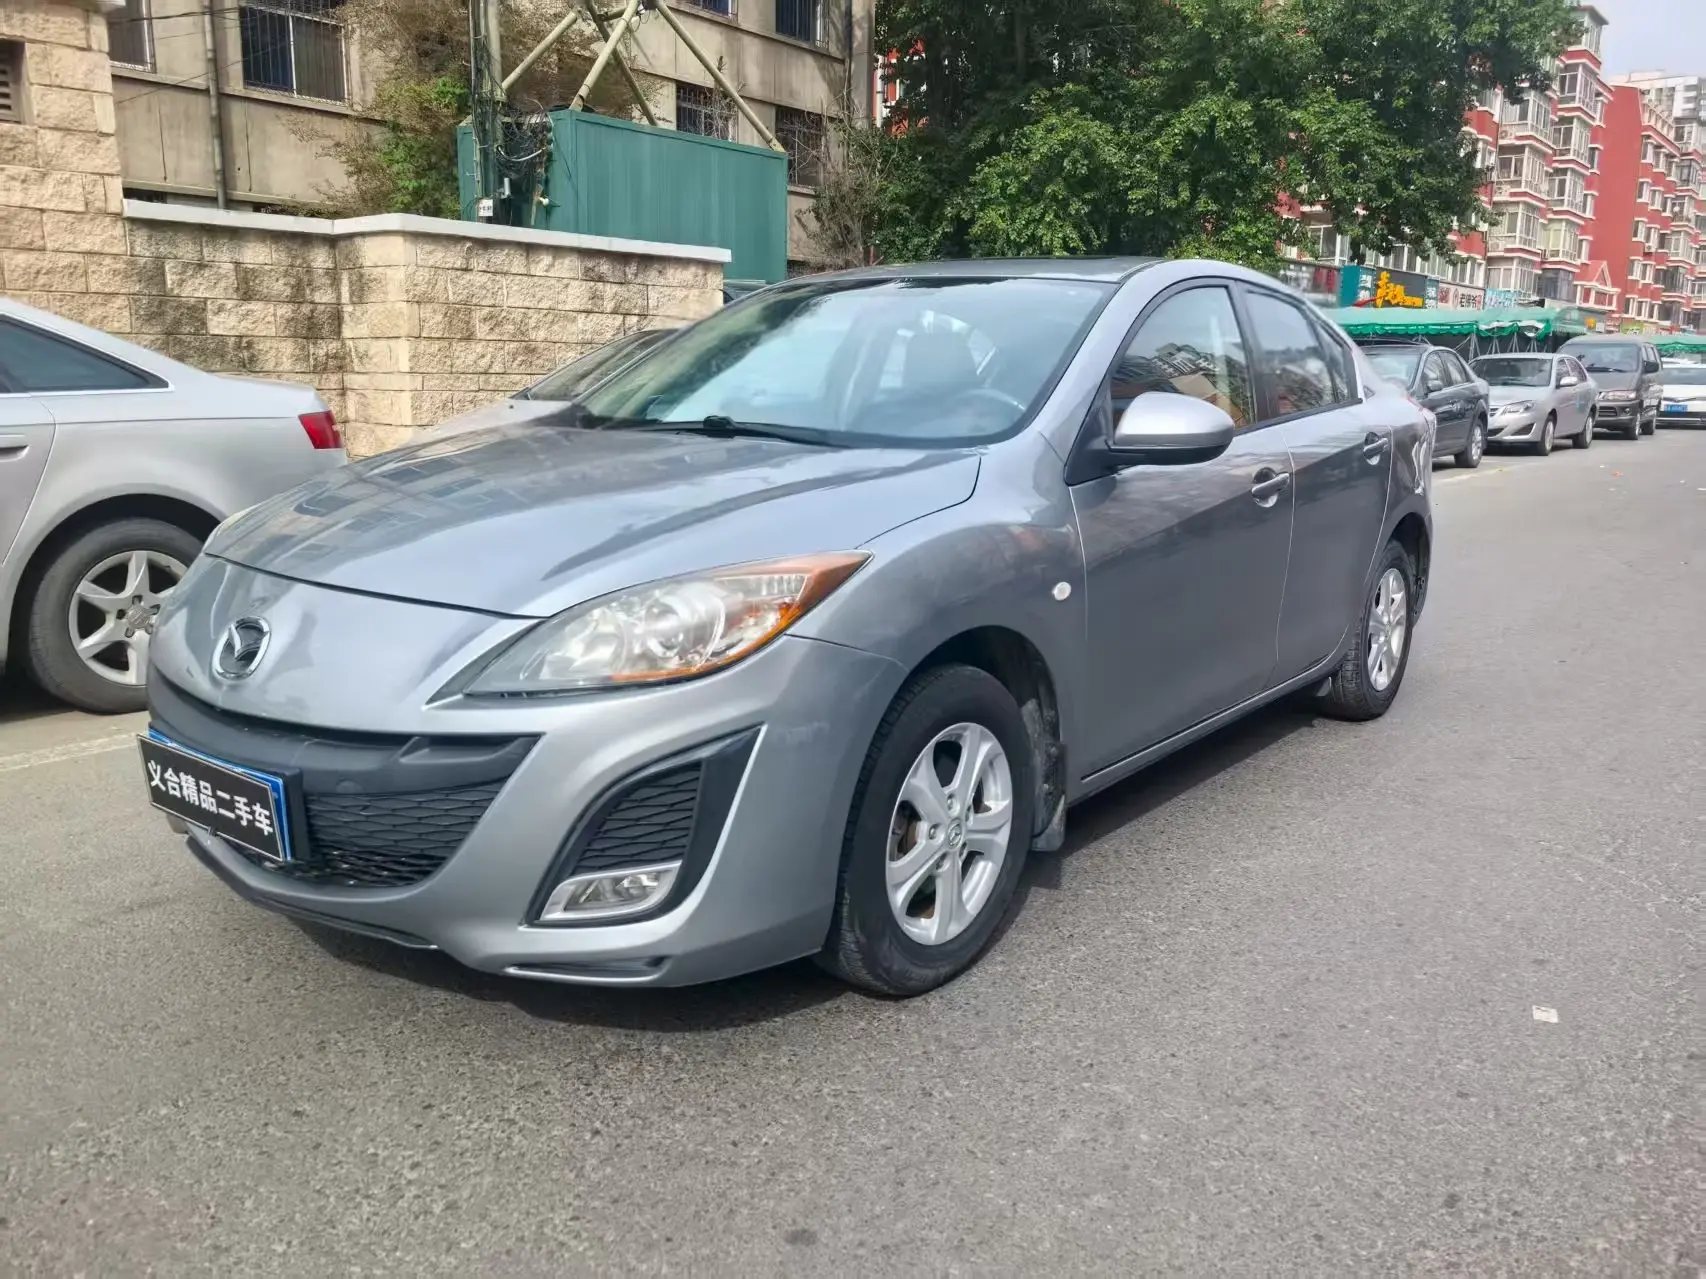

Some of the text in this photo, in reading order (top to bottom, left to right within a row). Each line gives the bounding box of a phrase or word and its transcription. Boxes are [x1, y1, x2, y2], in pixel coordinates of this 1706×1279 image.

[148, 760, 273, 835] 义合精品二手车
